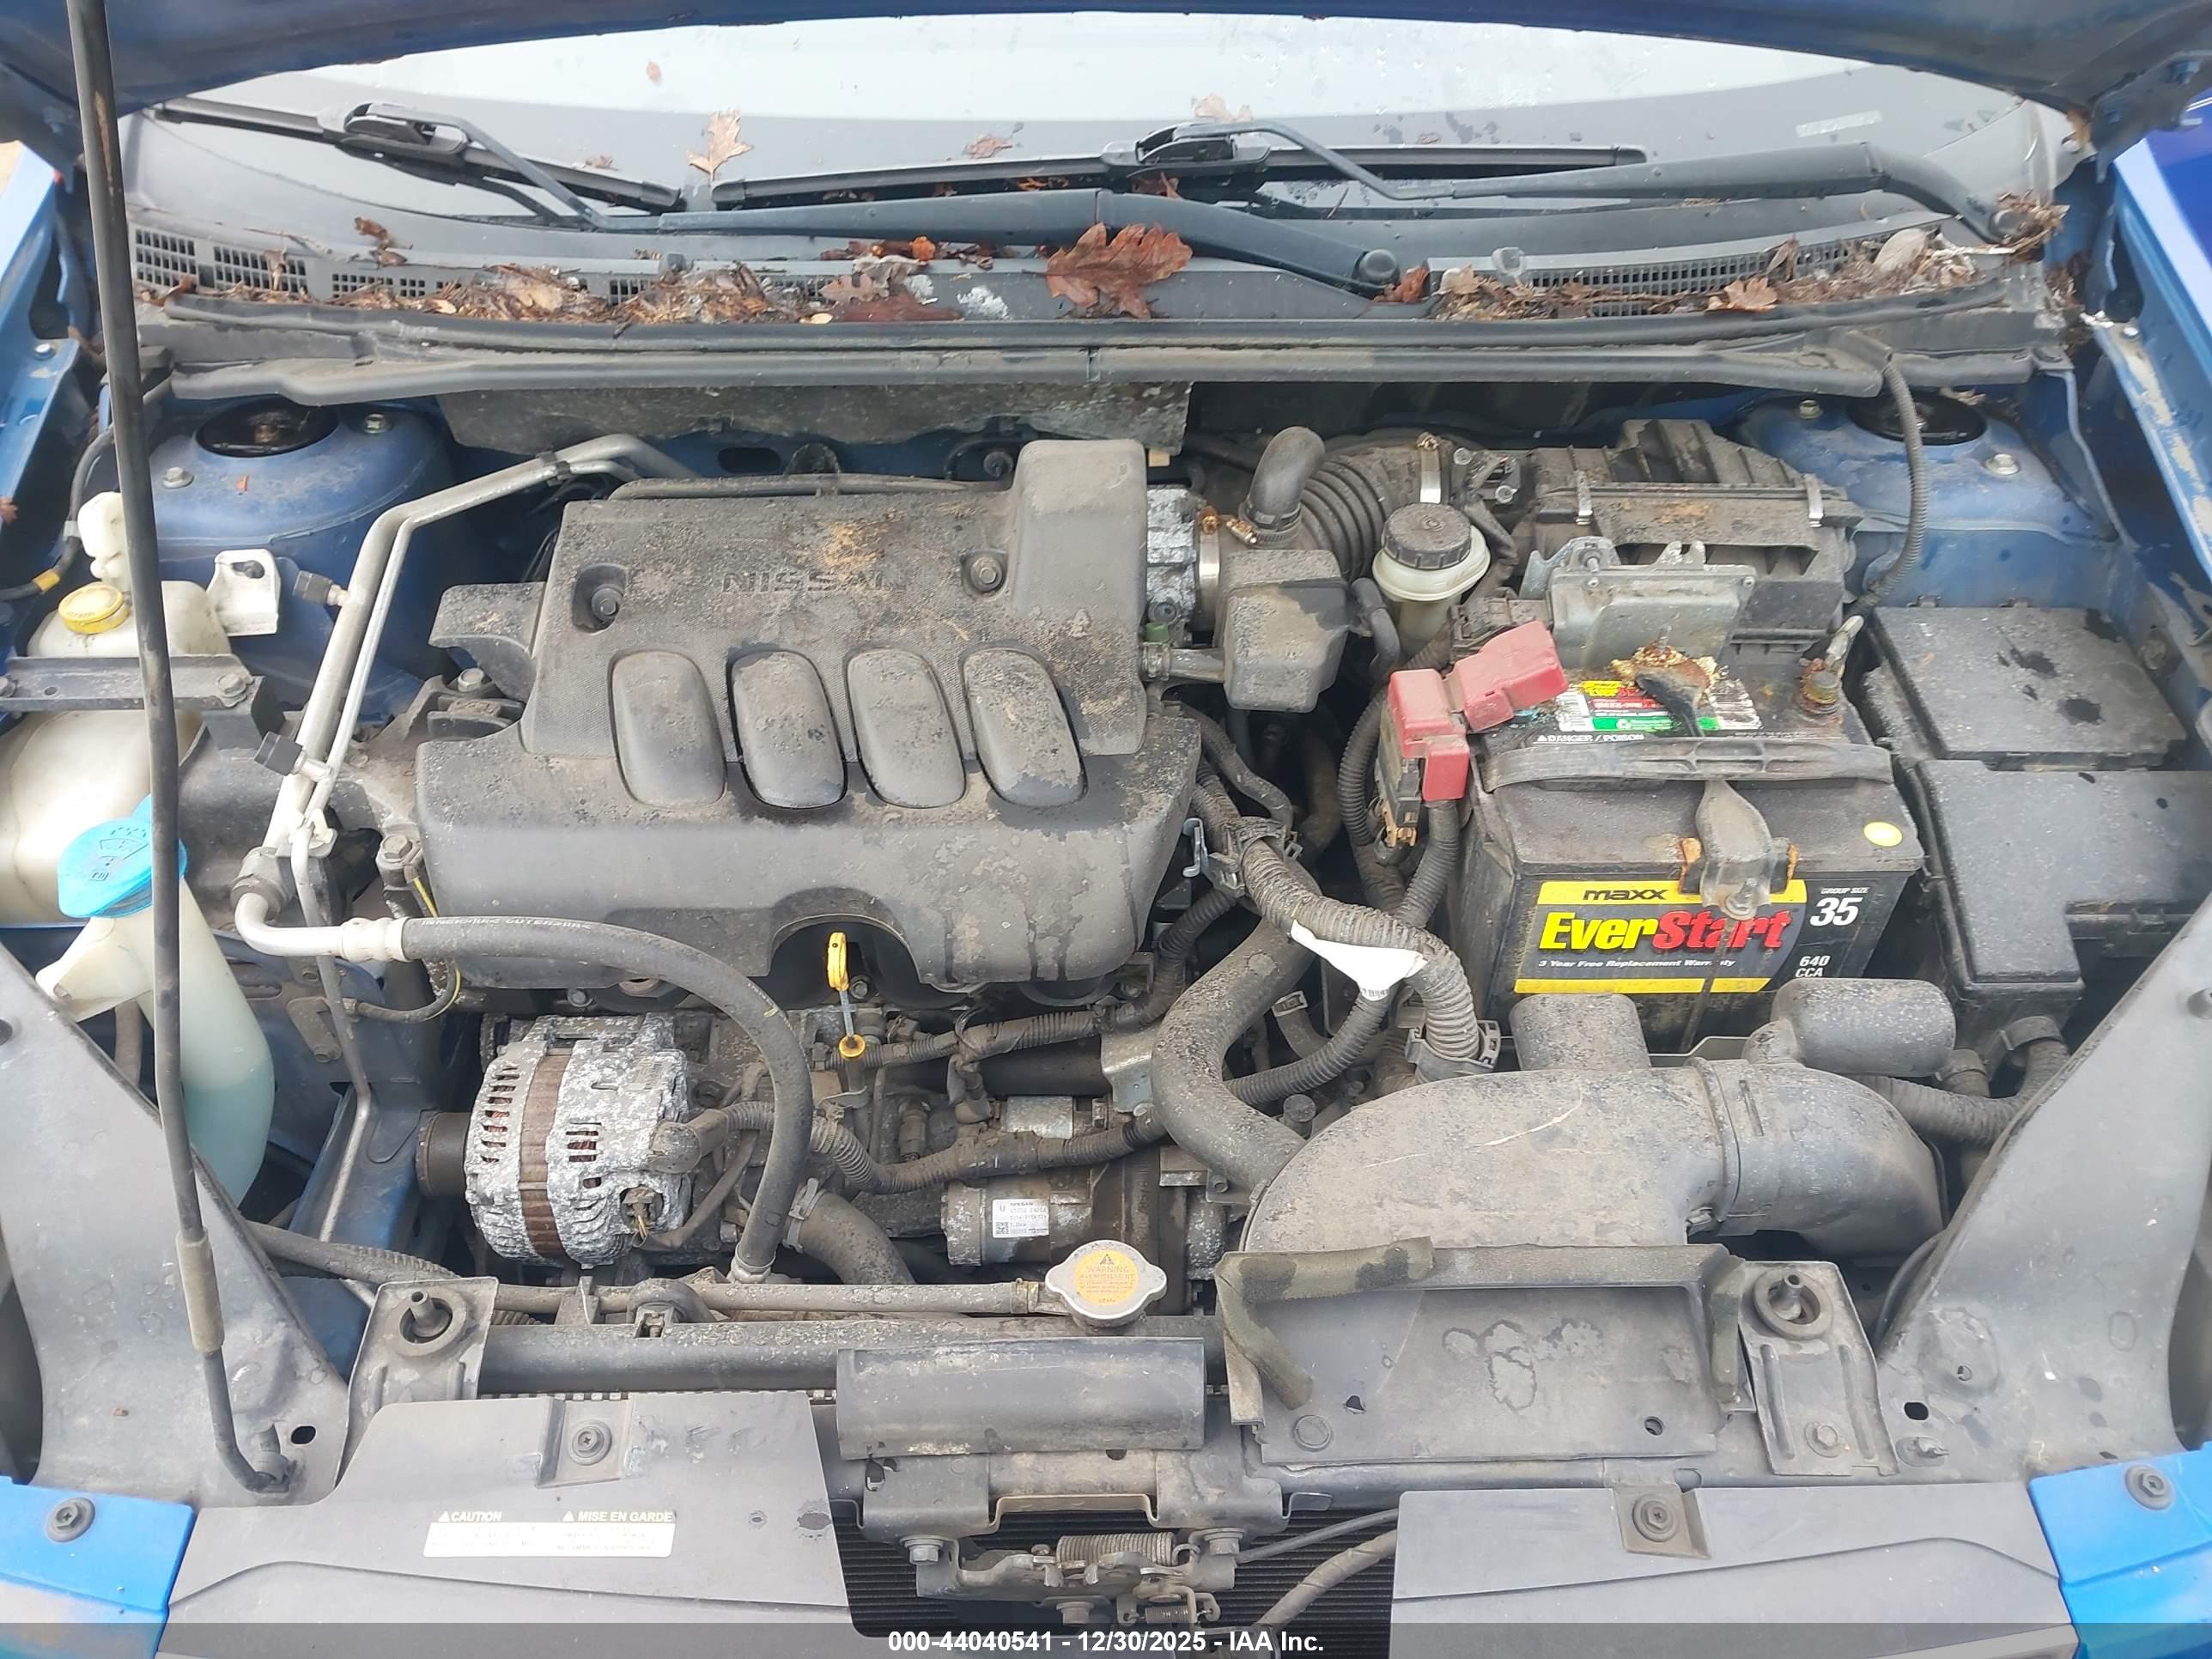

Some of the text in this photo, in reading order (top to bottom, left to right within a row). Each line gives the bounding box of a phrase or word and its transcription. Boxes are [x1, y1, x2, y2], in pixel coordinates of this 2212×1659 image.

[1583, 889, 1668, 901] maxx
[1809, 897, 1863, 927] 35
[1539, 908, 1792, 951] EverStart
[1799, 955, 1831, 967] 640
[1795, 967, 1824, 978] CCA
[450, 1511, 502, 1522] CAUTION
[577, 1511, 674, 1522] MISE EN GARDE
